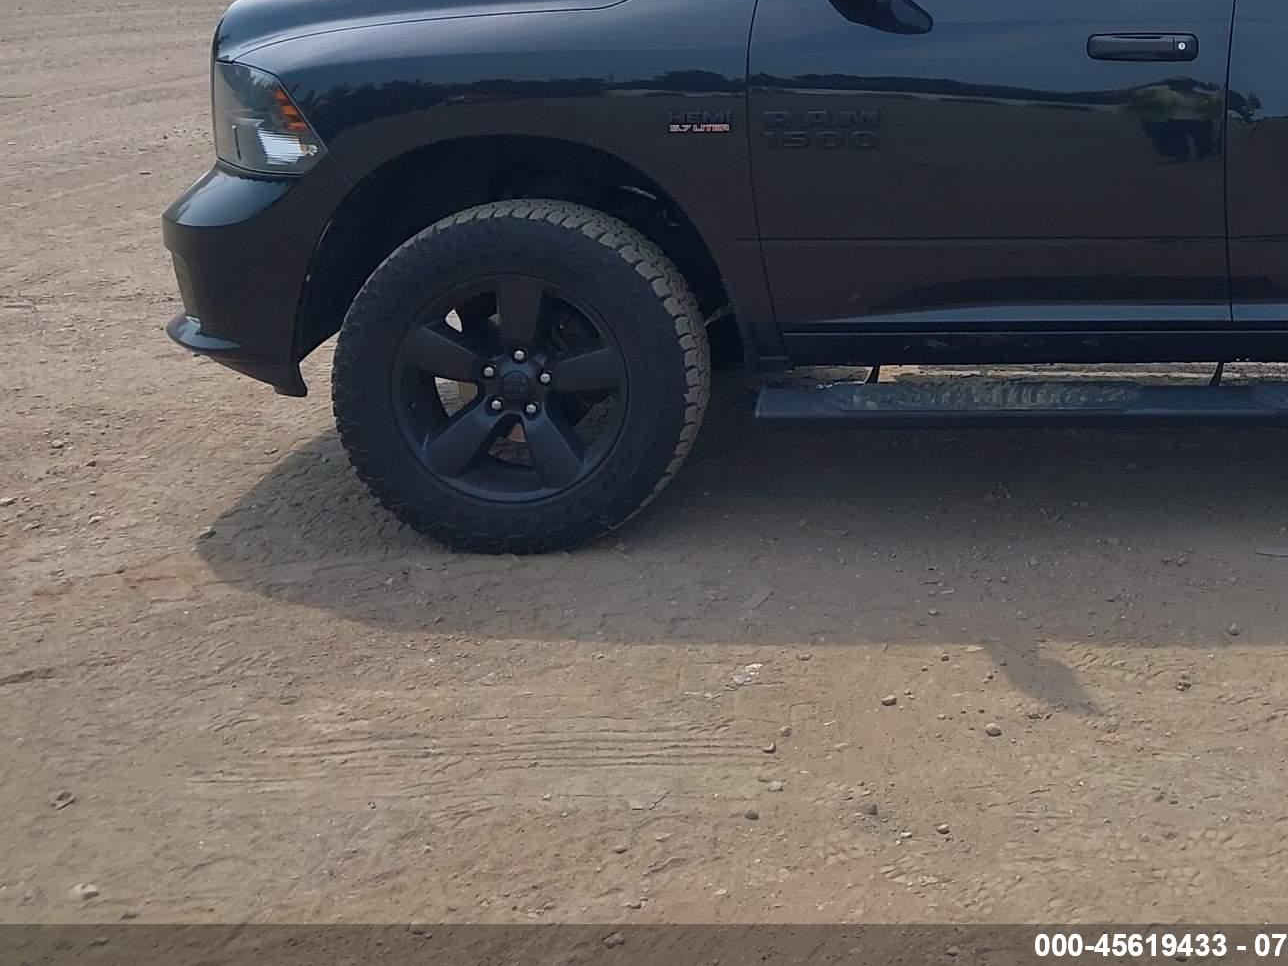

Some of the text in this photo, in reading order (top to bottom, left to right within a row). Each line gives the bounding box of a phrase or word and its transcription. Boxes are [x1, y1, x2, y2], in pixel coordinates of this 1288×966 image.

[667, 110, 733, 123] HEMI
[762, 109, 880, 130] RAM
[692, 124, 730, 132] LITER
[762, 131, 880, 150] 1500
